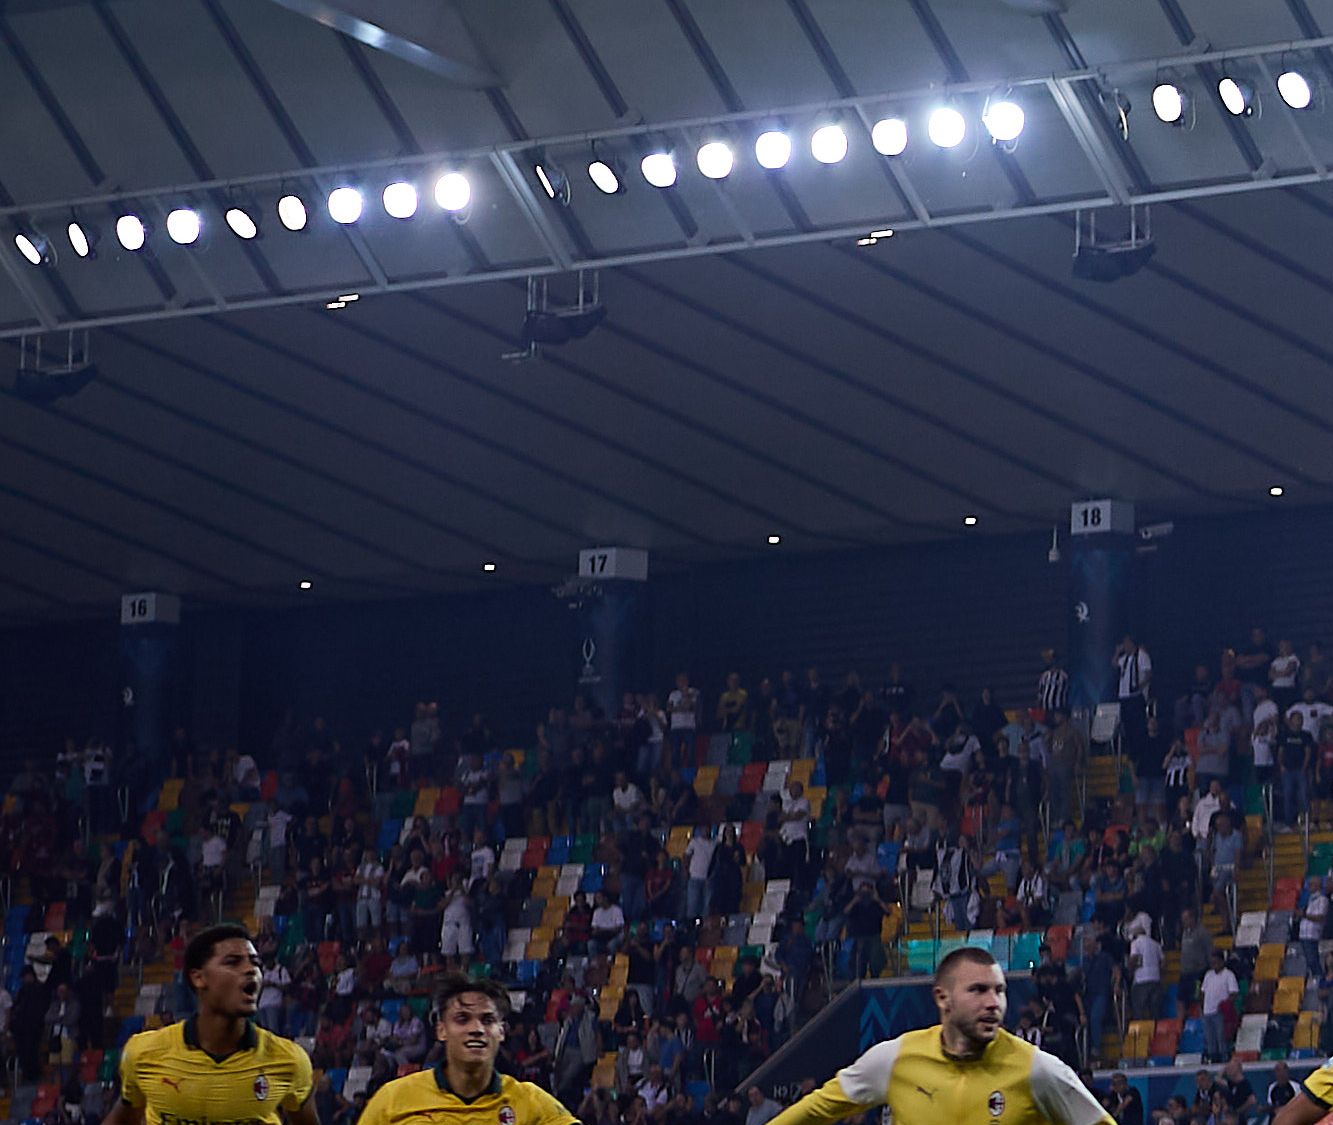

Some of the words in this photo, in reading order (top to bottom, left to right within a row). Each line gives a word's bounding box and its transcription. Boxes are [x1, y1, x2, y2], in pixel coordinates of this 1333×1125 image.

[1080, 508, 1102, 527] 18
[587, 554, 608, 573] 17
[129, 600, 148, 618] 16
